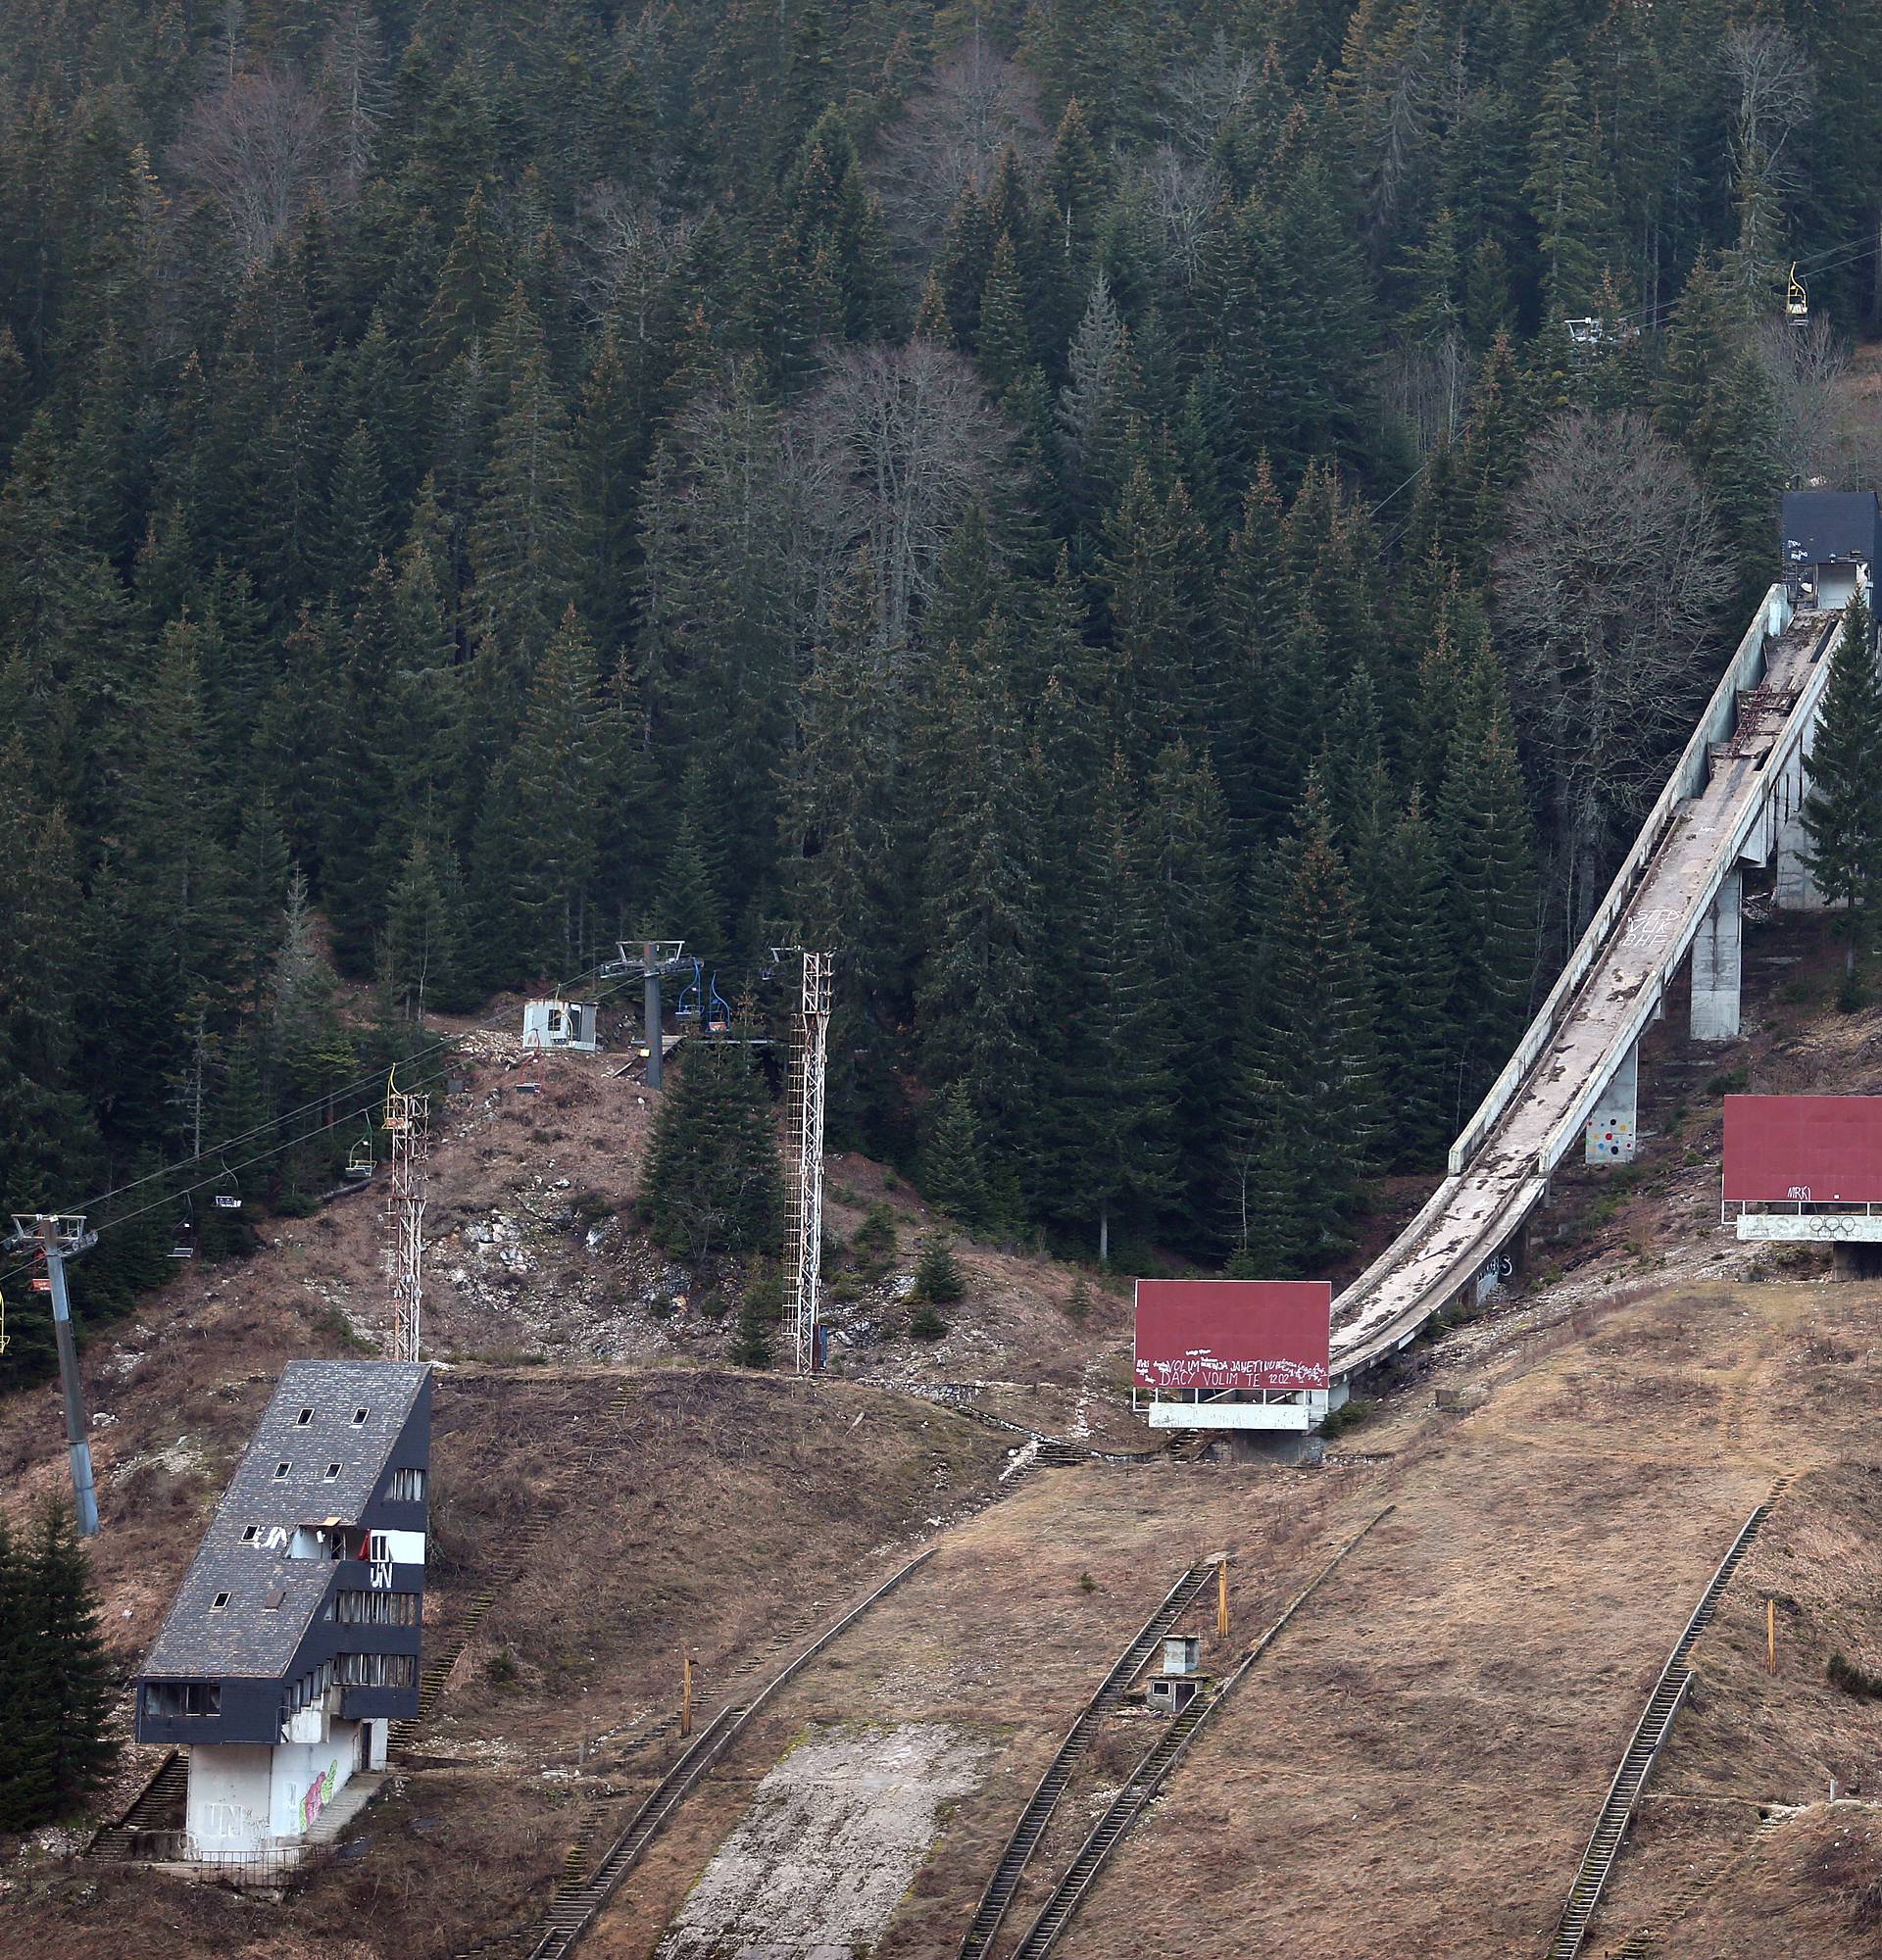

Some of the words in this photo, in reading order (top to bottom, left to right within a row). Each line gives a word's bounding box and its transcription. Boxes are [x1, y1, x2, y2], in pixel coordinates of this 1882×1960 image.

[1628, 918, 1671, 933] VUK
[1166, 1359, 1200, 1373] VOLIM
[1202, 1372, 1238, 1386] VOLIM
[1246, 1373, 1261, 1387] TE
[371, 1562, 392, 1589] UN
[204, 1802, 242, 1837] UN
